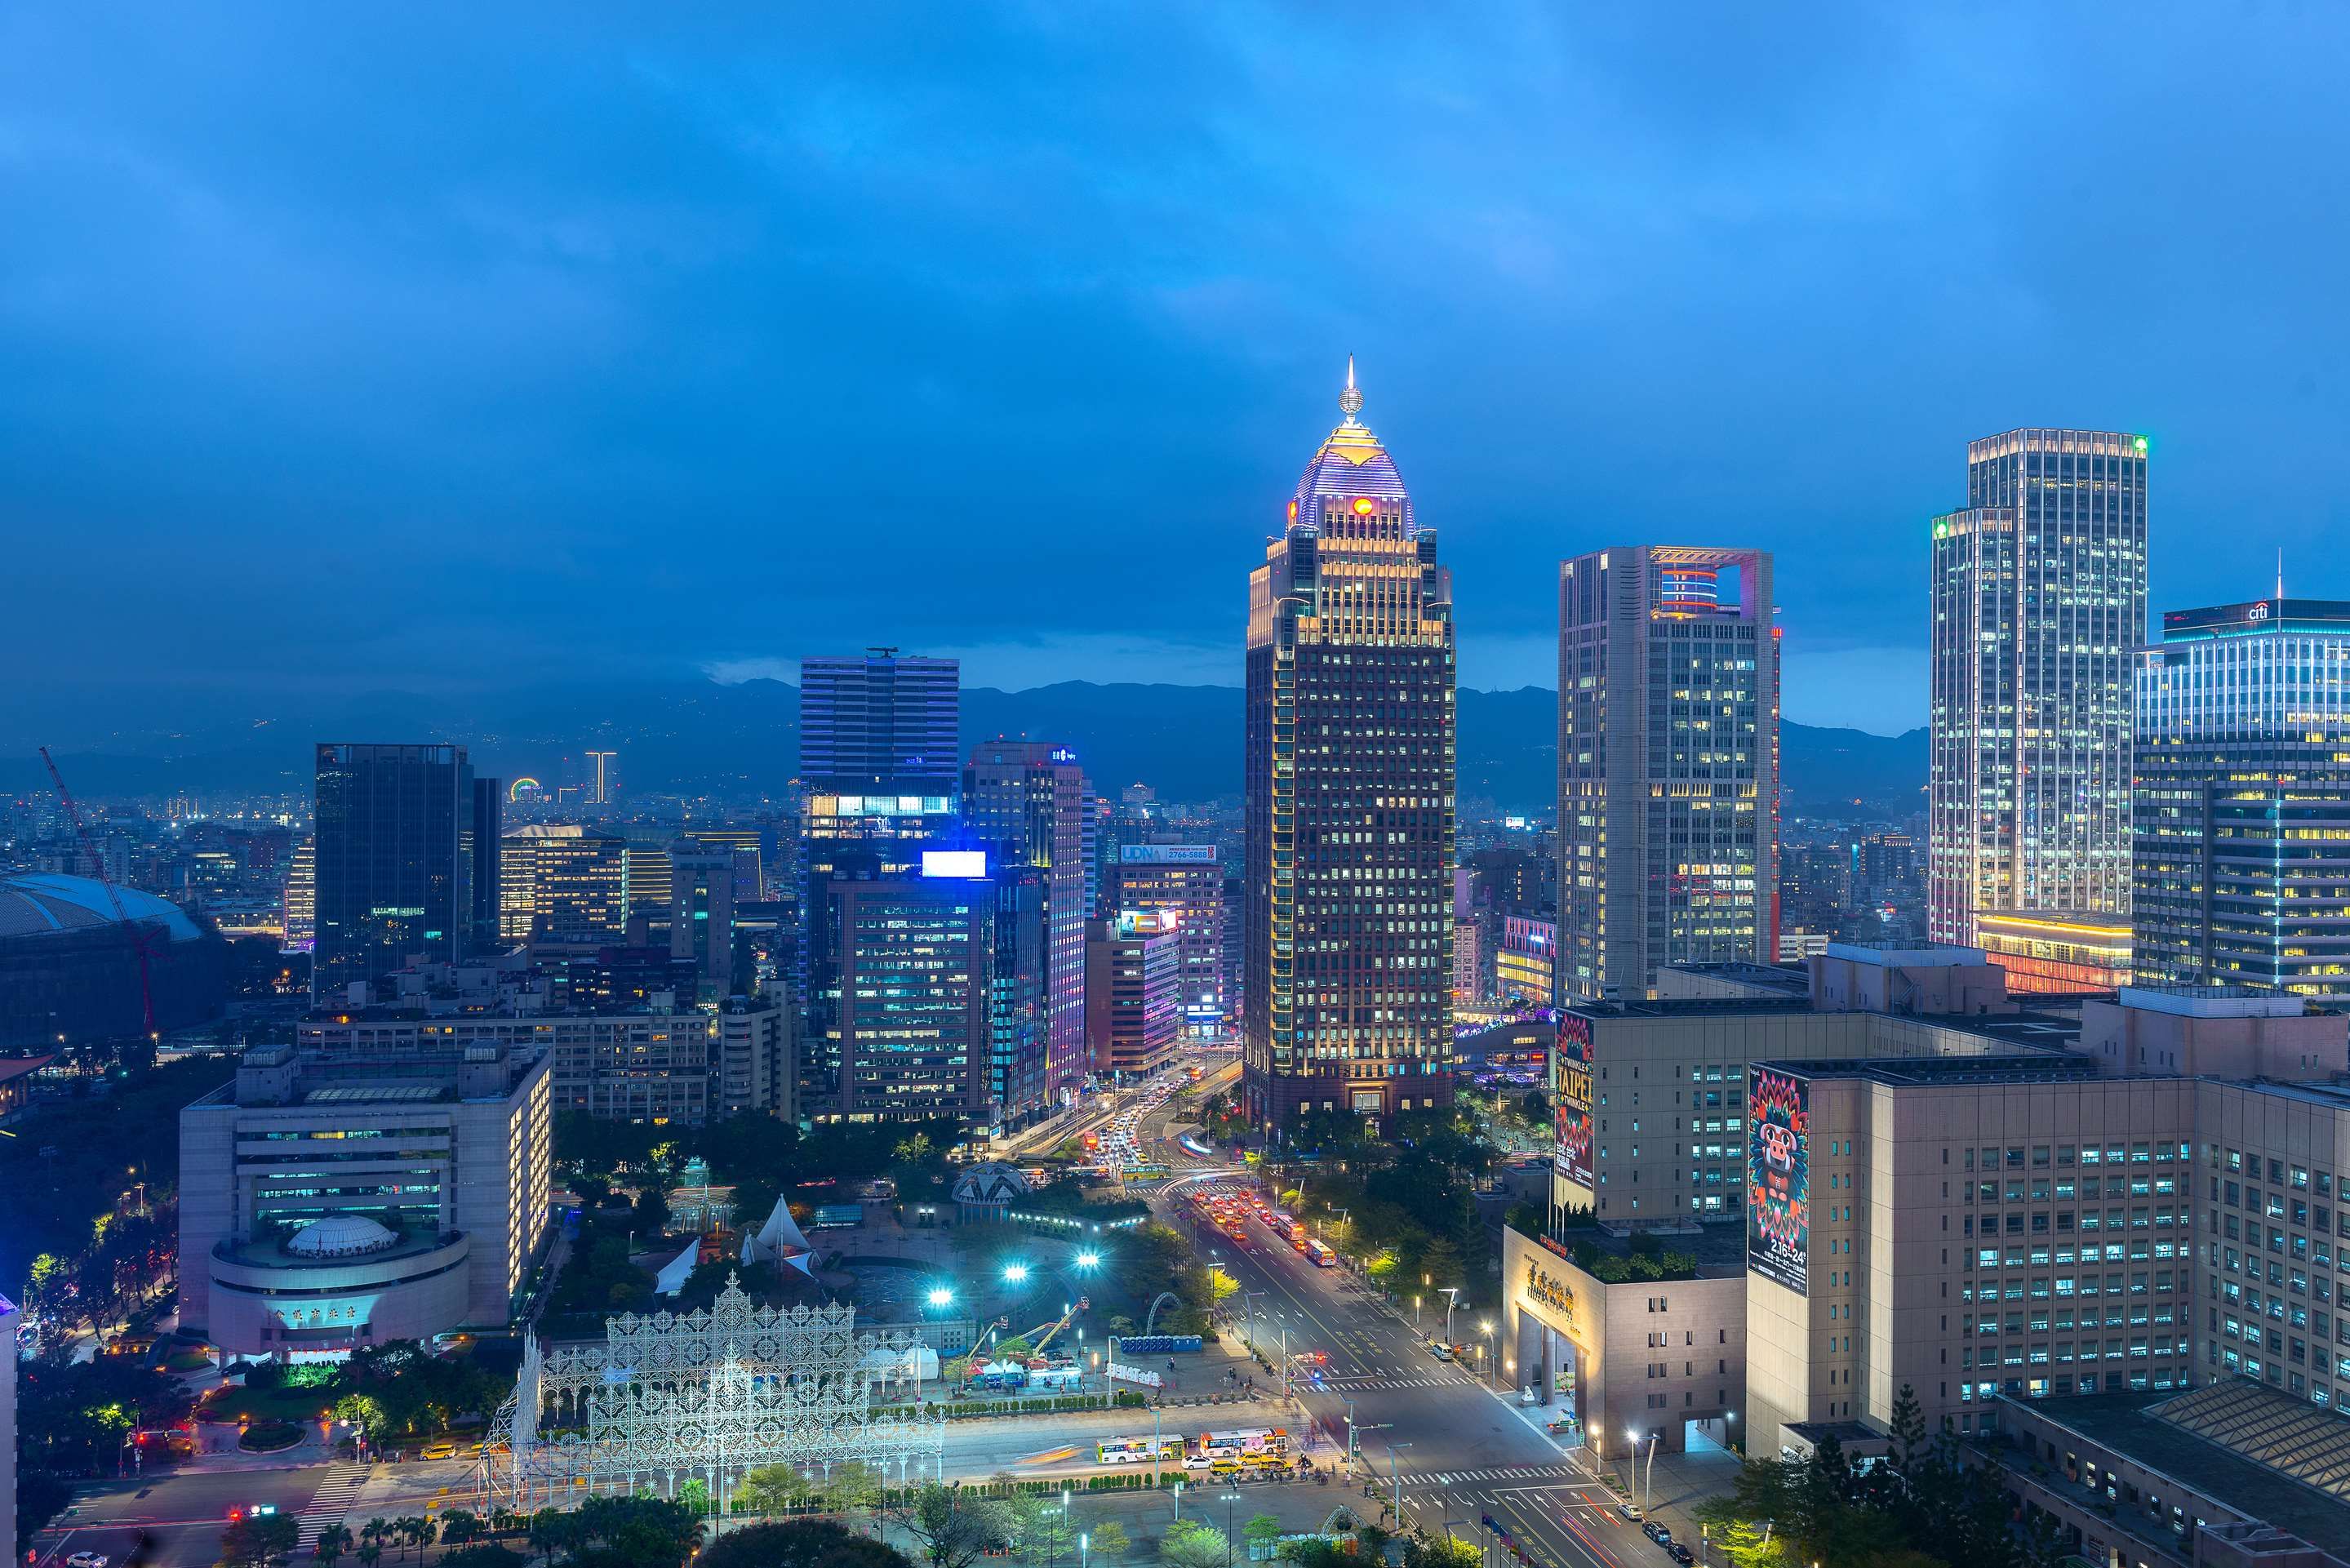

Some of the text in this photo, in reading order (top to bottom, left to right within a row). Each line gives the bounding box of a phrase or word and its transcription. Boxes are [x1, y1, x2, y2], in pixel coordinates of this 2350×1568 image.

[2249, 606, 2268, 620] citi
[1122, 847, 1153, 860] UDN
[1564, 1057, 1585, 1072] TWINKLE
[1557, 1066, 1593, 1103] TAIPEI
[1564, 1094, 1585, 1111] TWINKLE
